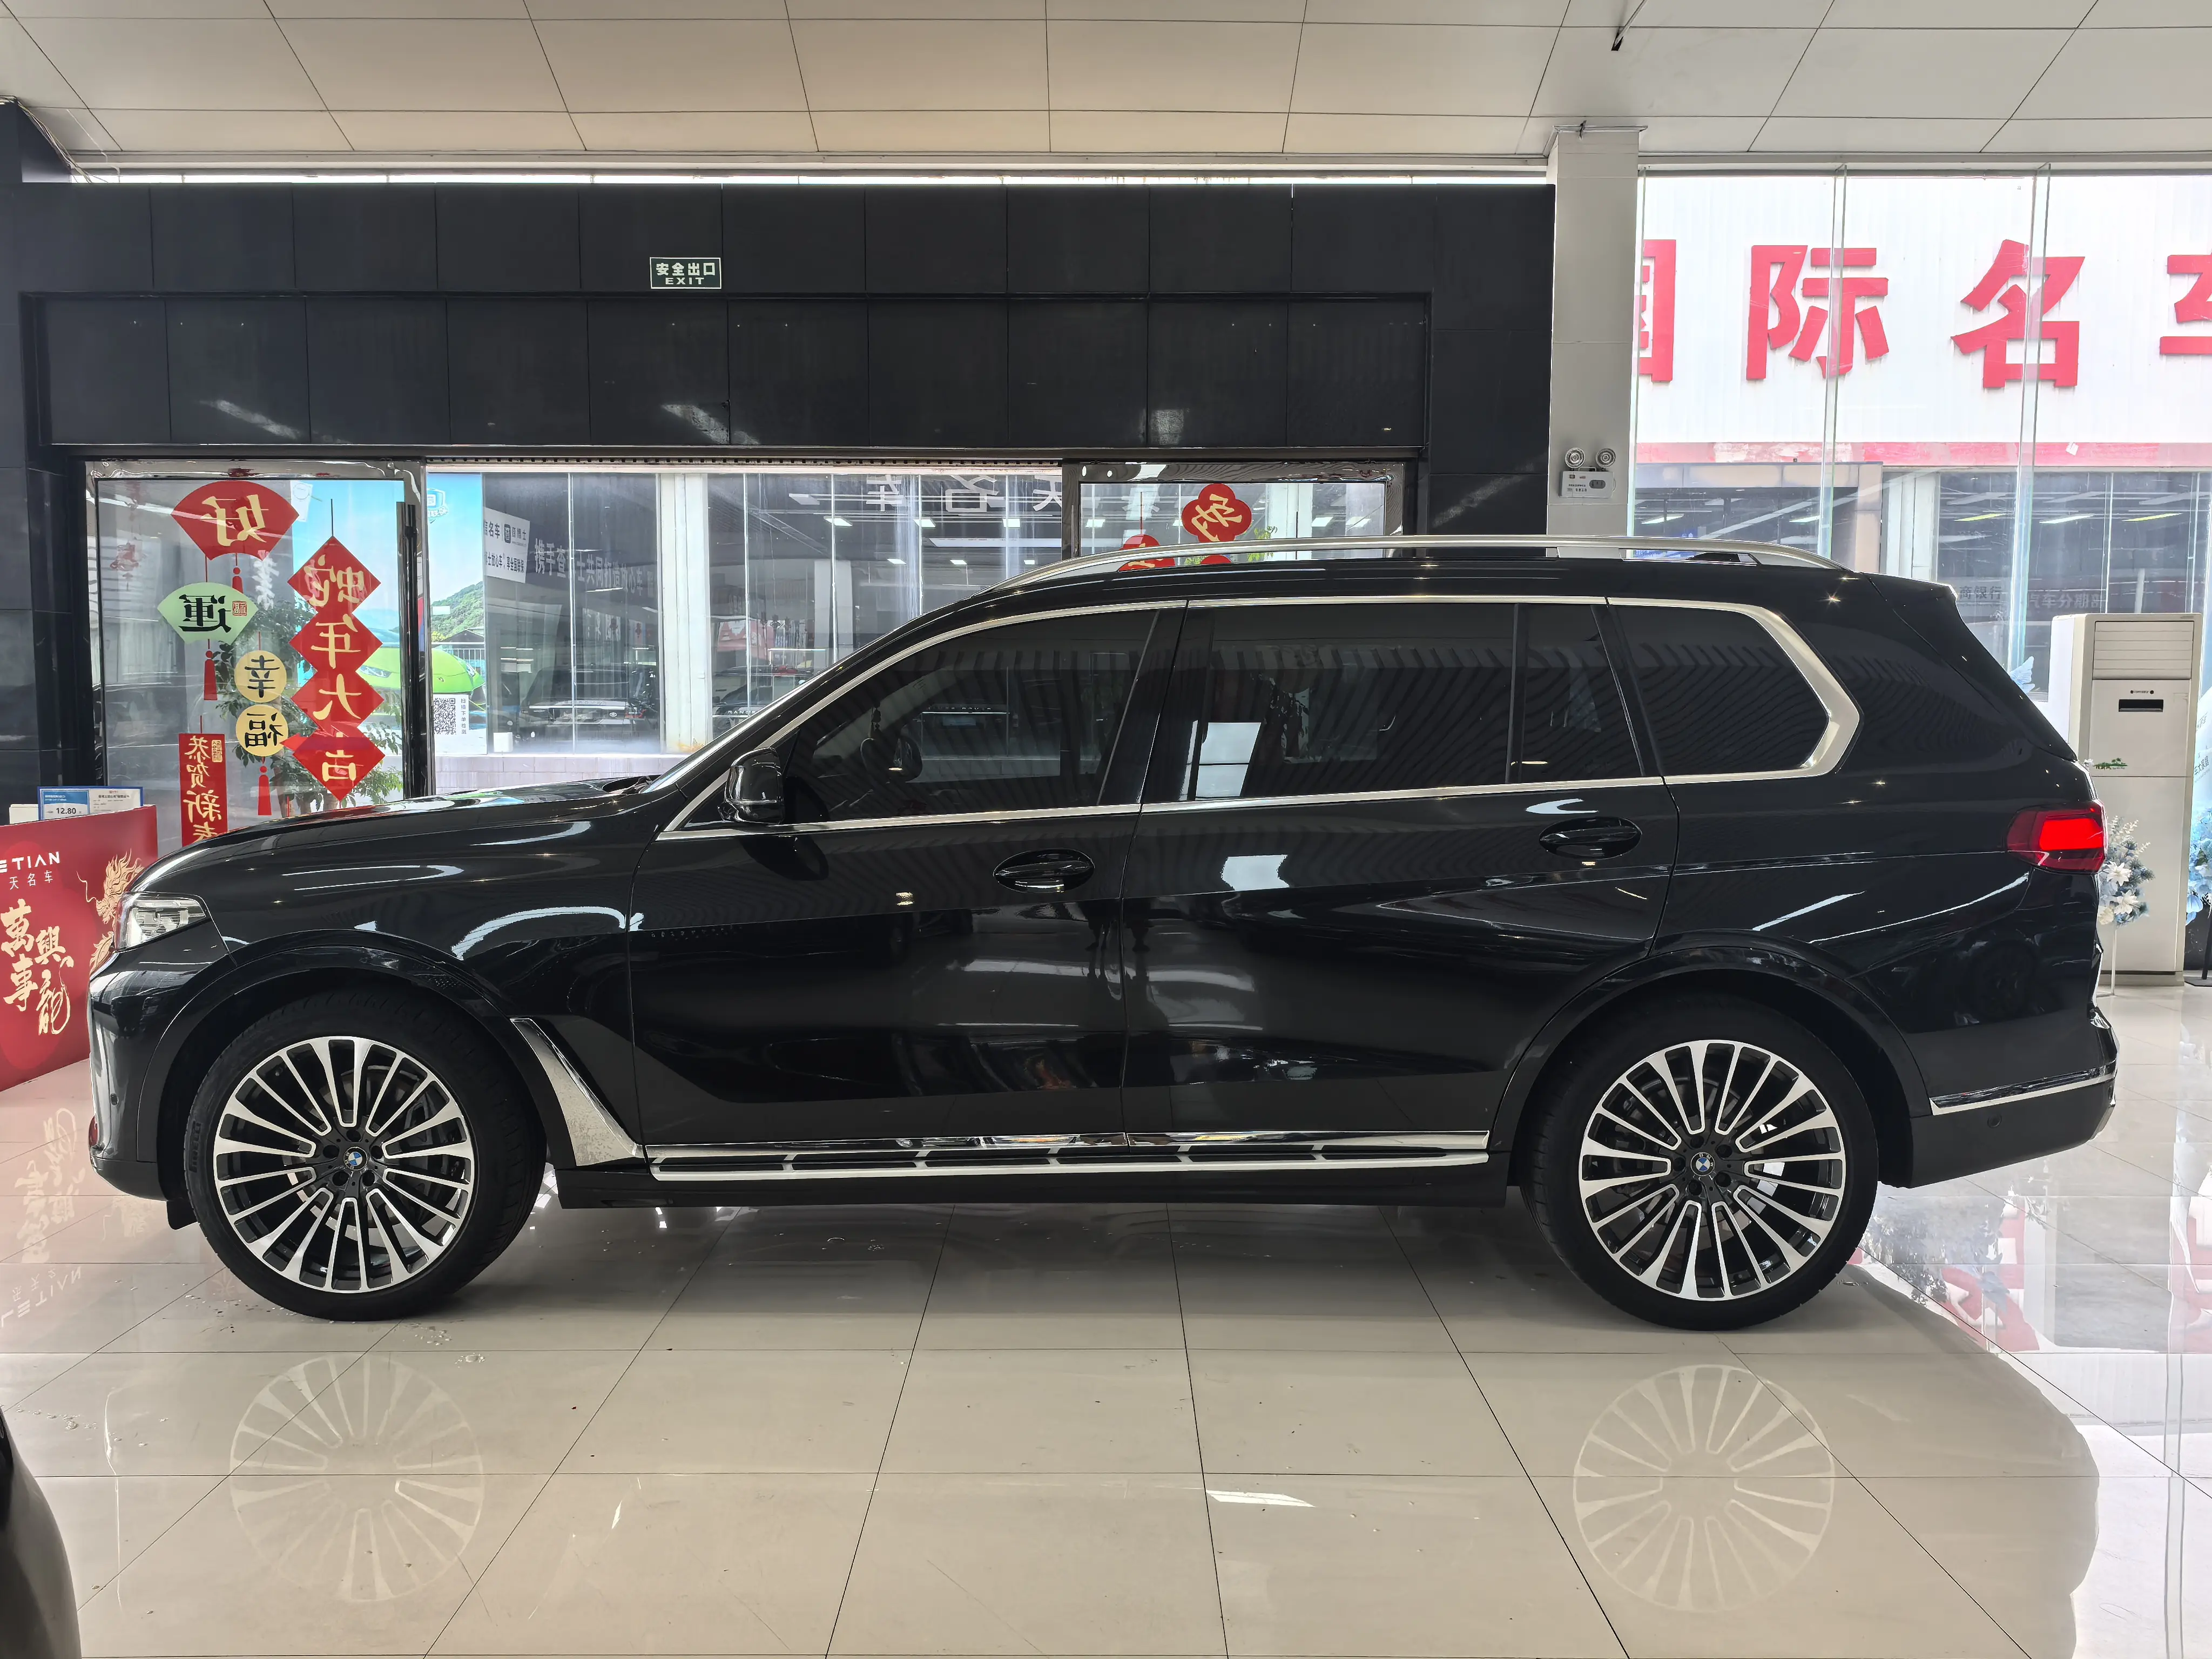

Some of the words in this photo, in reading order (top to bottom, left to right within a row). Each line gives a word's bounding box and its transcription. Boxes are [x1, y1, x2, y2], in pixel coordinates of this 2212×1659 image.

[656, 262, 715, 276] 安全出口
[9, 871, 53, 890] 天名车
